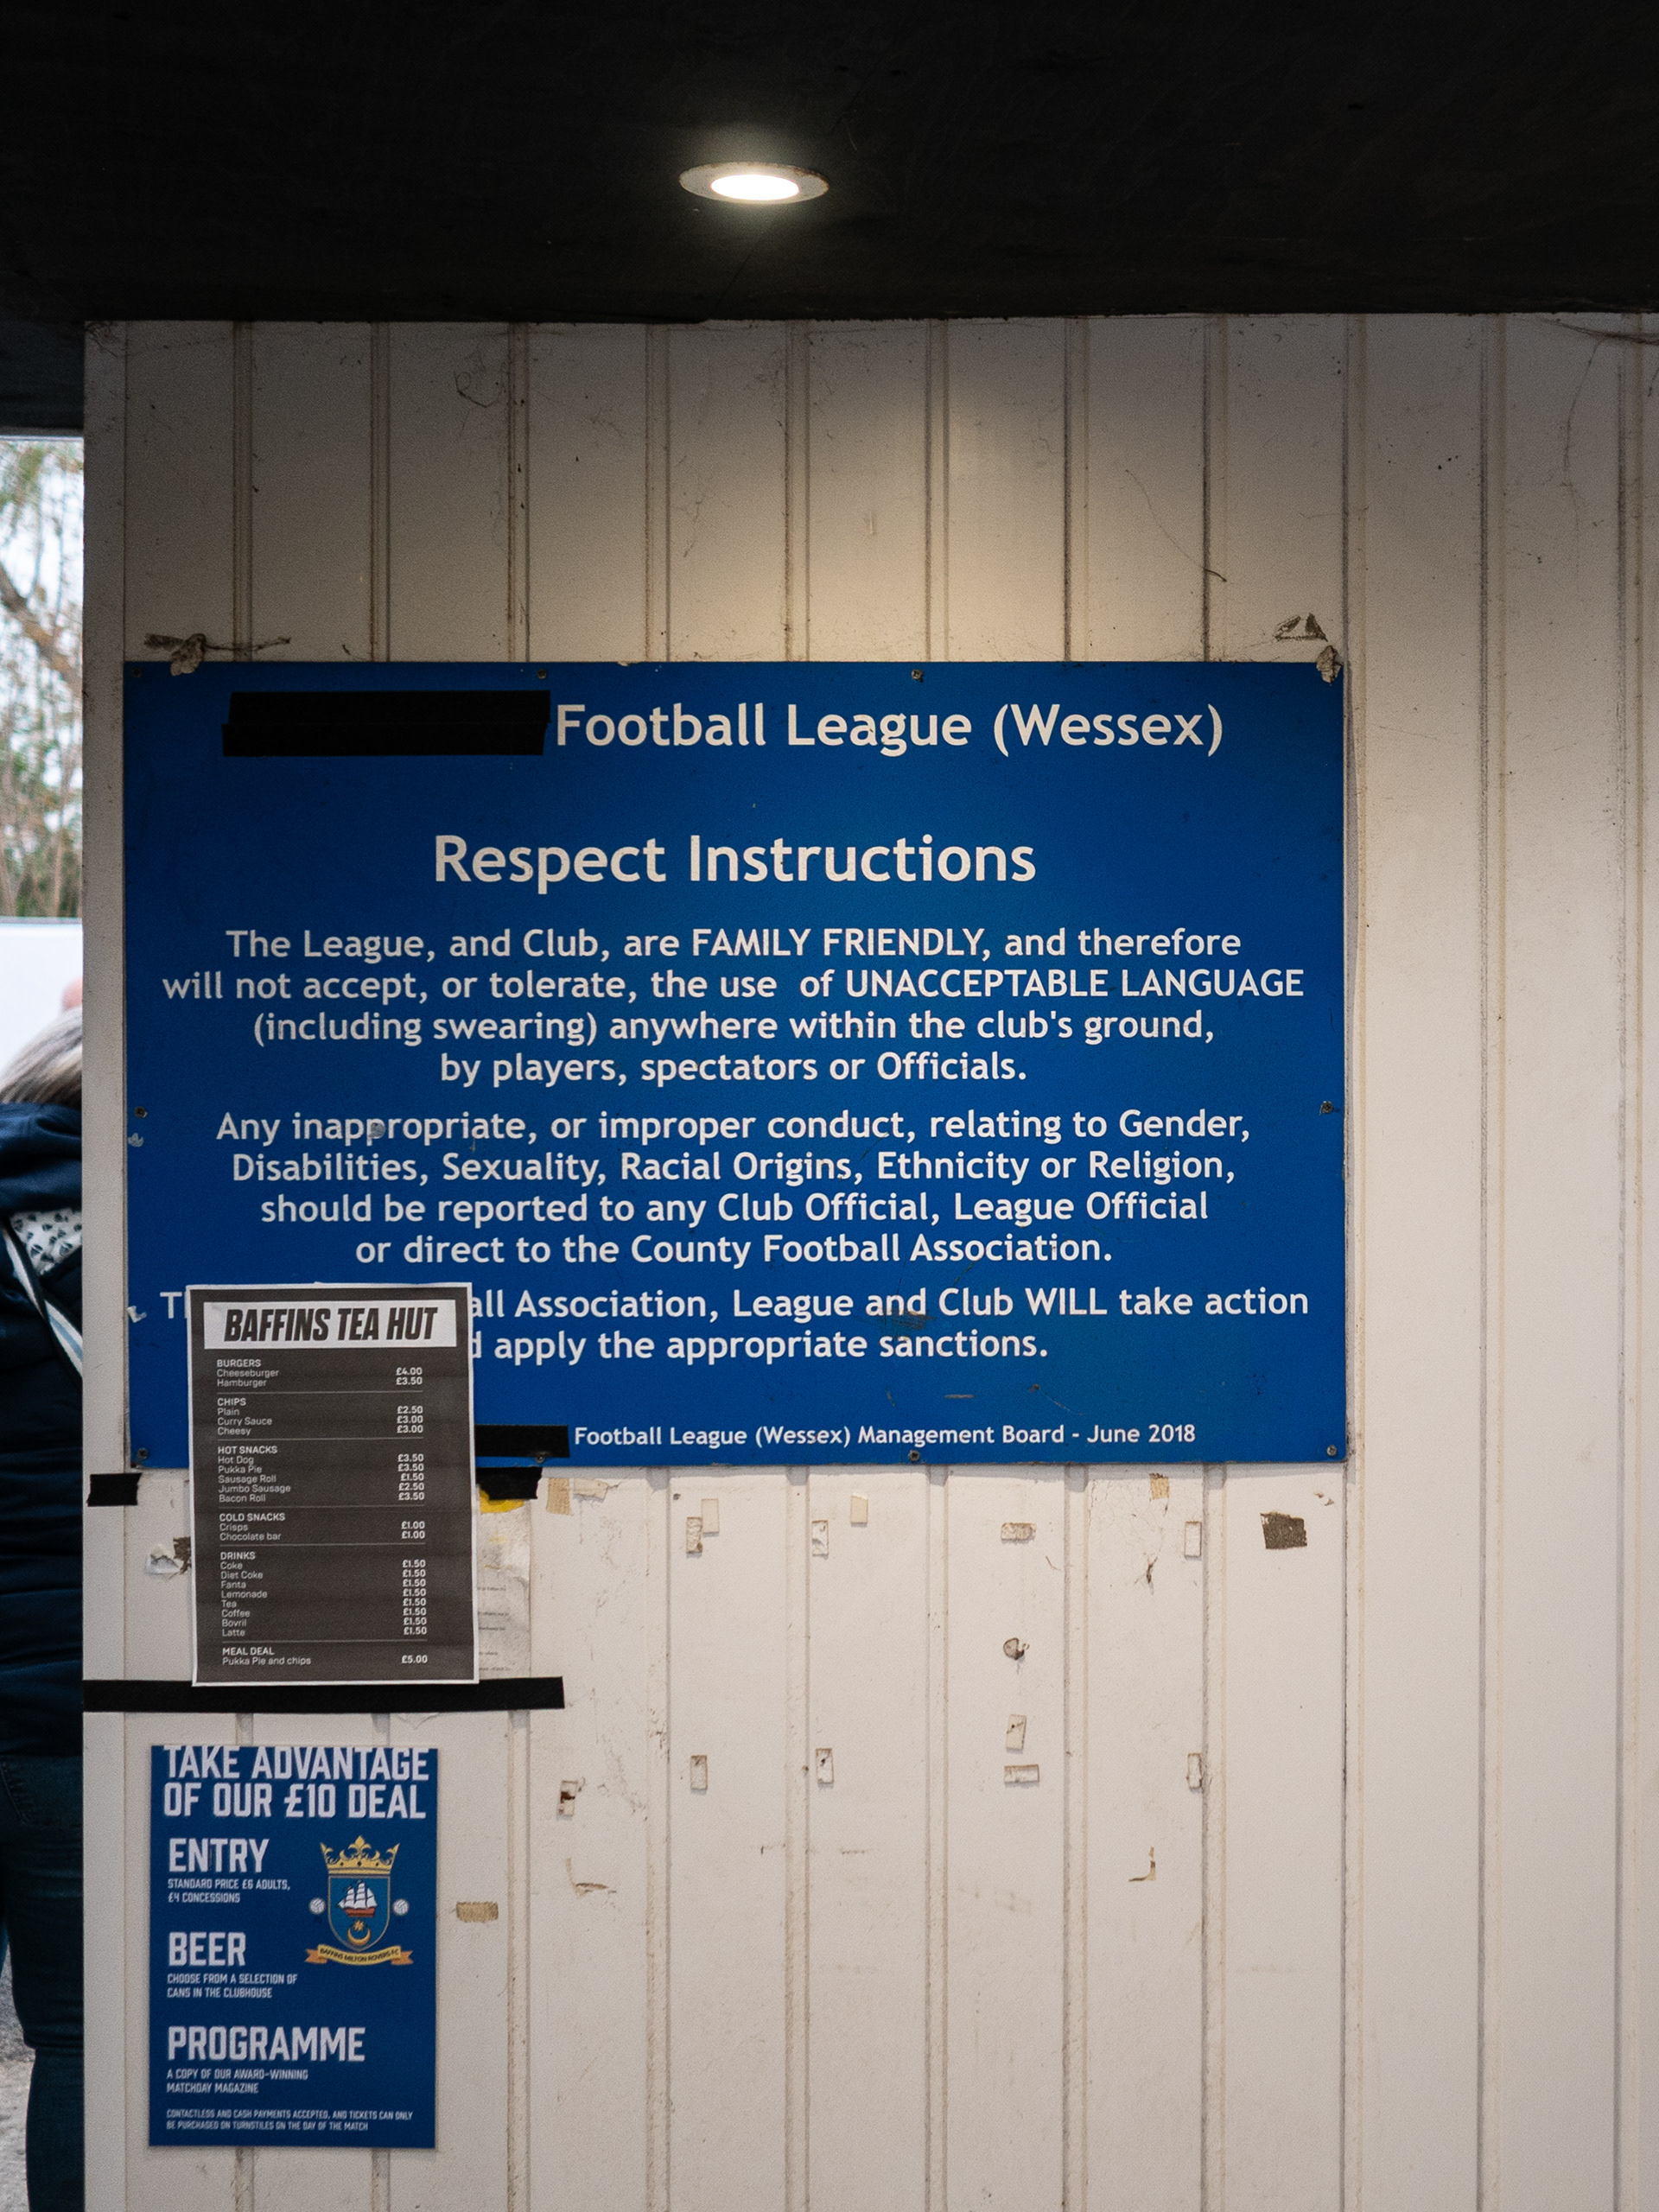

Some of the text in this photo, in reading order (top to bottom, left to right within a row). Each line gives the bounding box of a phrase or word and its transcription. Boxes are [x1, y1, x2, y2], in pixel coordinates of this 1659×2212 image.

[557, 702, 1222, 756] Football League (Wessex)
[435, 834, 1035, 893] Respect Instructions
[226, 927, 1240, 963] The League, and Club, are FAMILY FRIENDLY, and therefore
[162, 969, 1303, 1004] will not accept, or tolerate, the use of UNACCEPTABLE LANGUAGE
[254, 1009, 1212, 1046] (including swearing) anywhere within the club's ground,
[217, 1109, 1249, 1146] Any inappropriate, or improper conduct, relating to Gender,
[233, 1150, 1234, 1186] Disabilities, Sexuality, Racial Origins, Ethnicity or Religion,
[224, 1307, 437, 1341] BAFFINS TEA HUT
[217, 1358, 261, 1367] BURGERS
[216, 1369, 278, 1378] Cheeseburger
[217, 1379, 266, 1388] Hamburger
[217, 1397, 245, 1406] CHIPS
[397, 1405, 423, 1414] £2.50
[217, 1414, 423, 1426] Curry Sauce £3.00
[217, 1427, 251, 1435] Cheesy
[575, 1427, 661, 1445] Football
[671, 1427, 747, 1448] League
[755, 1426, 850, 1447] (Wessex)
[858, 1426, 994, 1446] Management
[1002, 1424, 1064, 1443] Board
[1087, 1425, 1140, 1442] June
[1148, 1424, 1195, 1442] 2018
[218, 1446, 237, 1454] HOT
[236, 1455, 253, 1465] Dog
[218, 1463, 423, 1473] Pukka Pie £3.50
[218, 1474, 257, 1484] Sausage
[401, 1472, 423, 1481] £1.50
[251, 1484, 290, 1493] Sausage
[398, 1482, 424, 1491] £2.50
[247, 1512, 285, 1521] SNACKS
[219, 1522, 248, 1532] Crisps
[219, 1532, 264, 1541] Chocolate
[222, 1656, 250, 1665] Pukka
[251, 1656, 265, 1665] Pie
[287, 1656, 311, 1665] chips
[402, 1655, 427, 1663] £5.00
[163, 1745, 429, 1780] TAKE ADVANTAGE
[164, 1782, 426, 1818] OF OUR £10 DEAL
[169, 1838, 269, 1872] ENTRY
[168, 1878, 289, 1890] STANDARD PRICE £6 ADULTS,
[168, 1891, 240, 1903] £4 CONCESSIONS
[168, 1931, 245, 1966] BEER
[168, 1973, 297, 1984] CHOOSE FROM A SELECTION OF
[167, 1986, 271, 1998] CANS IN THE CLUBHOUSE
[168, 2026, 365, 2061] PROGRAMME
[167, 2069, 308, 2080] A COPY OF OUR AWARD-WINNING
[167, 2082, 258, 2093] MATCHDAY MAGAZINE
